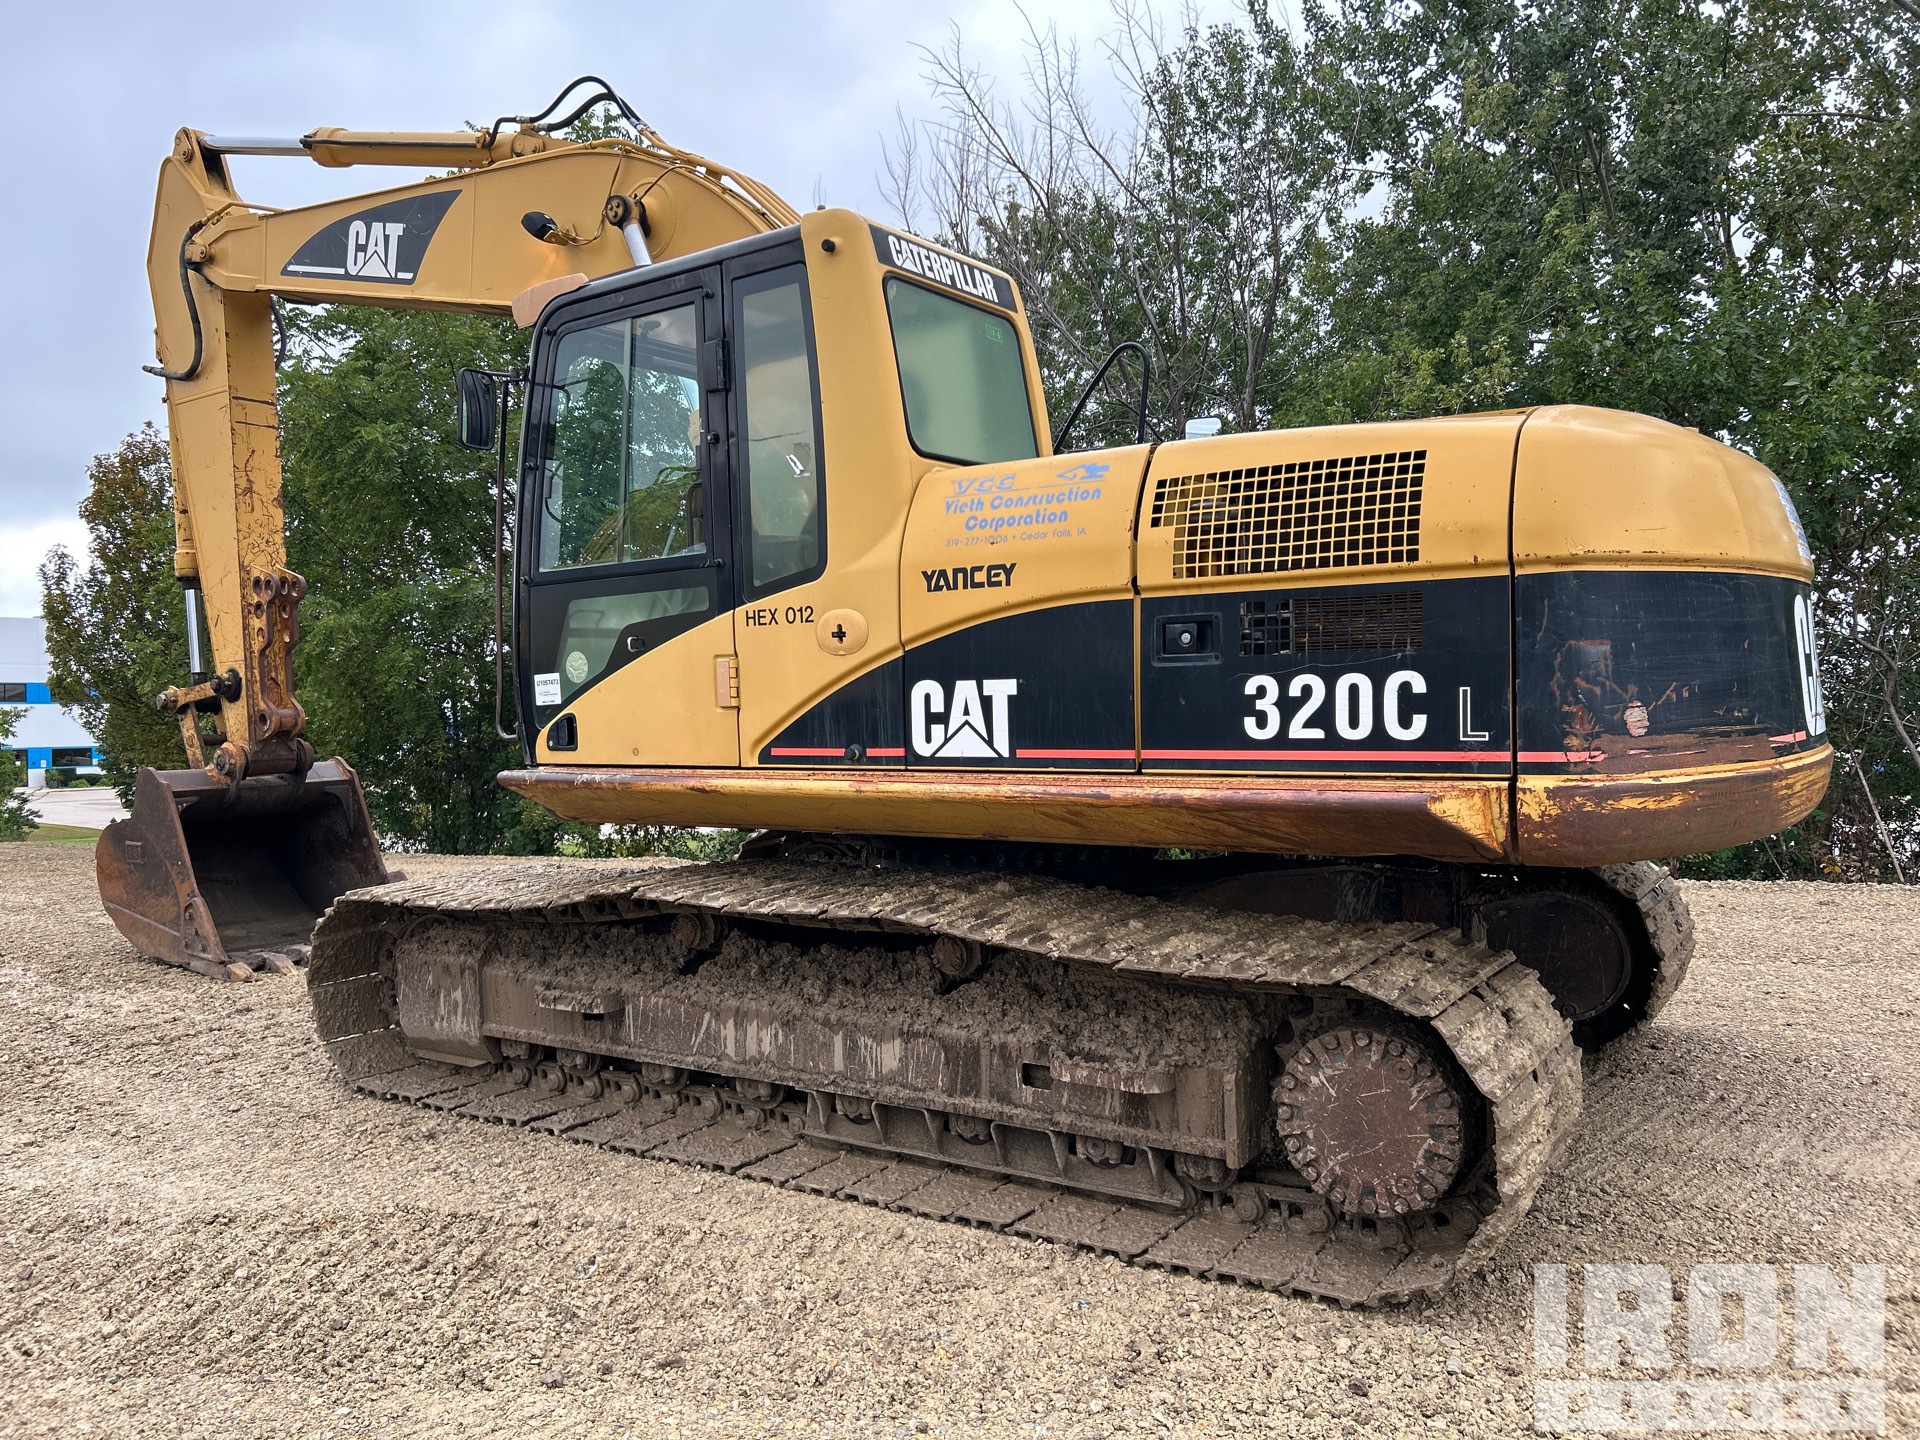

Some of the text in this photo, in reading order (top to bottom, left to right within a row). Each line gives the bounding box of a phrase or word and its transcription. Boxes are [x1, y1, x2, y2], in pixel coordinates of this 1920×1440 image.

[346, 220, 404, 279] CAT
[887, 234, 999, 303] CATERPILLAR
[945, 486, 1102, 514] Vieth Construction
[964, 508, 1069, 532] Corporation
[945, 535, 1008, 548] 319-277-1006
[1020, 529, 1048, 541] Cedar
[1076, 527, 1087, 536] IA
[921, 562, 1017, 593] YANCEY
[745, 605, 815, 627] HEX 012
[910, 678, 1018, 758] CAT
[1243, 669, 1490, 742] 320C L
